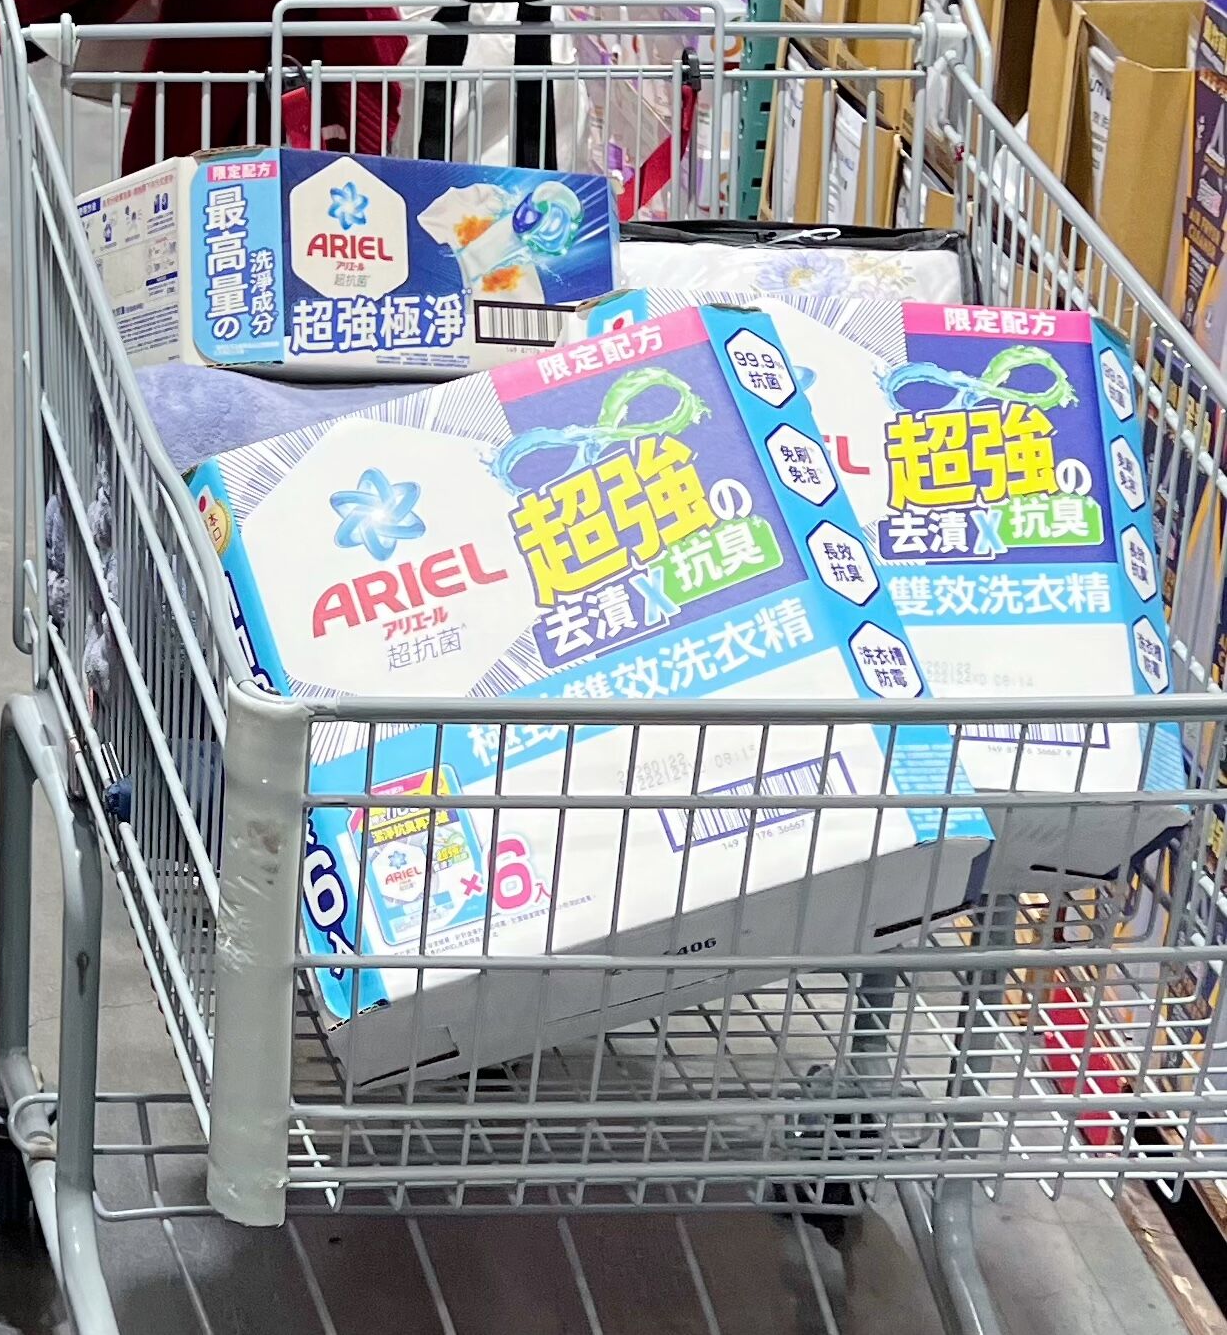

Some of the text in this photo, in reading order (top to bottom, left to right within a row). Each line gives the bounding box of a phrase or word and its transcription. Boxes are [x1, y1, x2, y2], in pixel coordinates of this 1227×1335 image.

[213, 163, 271, 180] 限定配方
[205, 185, 249, 340] 最高量の
[306, 233, 394, 262] ARIEL
[250, 248, 274, 336] 洗淨成分
[334, 273, 369, 288] 超抗菌
[290, 293, 466, 352] 超強極淨
[943, 308, 1056, 337] 限定配方
[537, 324, 663, 385] 限定配方
[748, 372, 781, 391] 抗菌
[780, 444, 812, 464] 免刷
[888, 403, 1092, 510] 超強の
[513, 435, 753, 606] 超強の
[824, 542, 855, 562] 長效
[831, 563, 864, 583] 抗臭
[311, 546, 508, 639] ARIEL
[888, 571, 1111, 617] 雙效洗衣精
[382, 606, 448, 641] アリエール
[387, 627, 462, 671] 超抗菌
[859, 646, 907, 668] 洗衣槽
[385, 865, 422, 886] ARIEL
